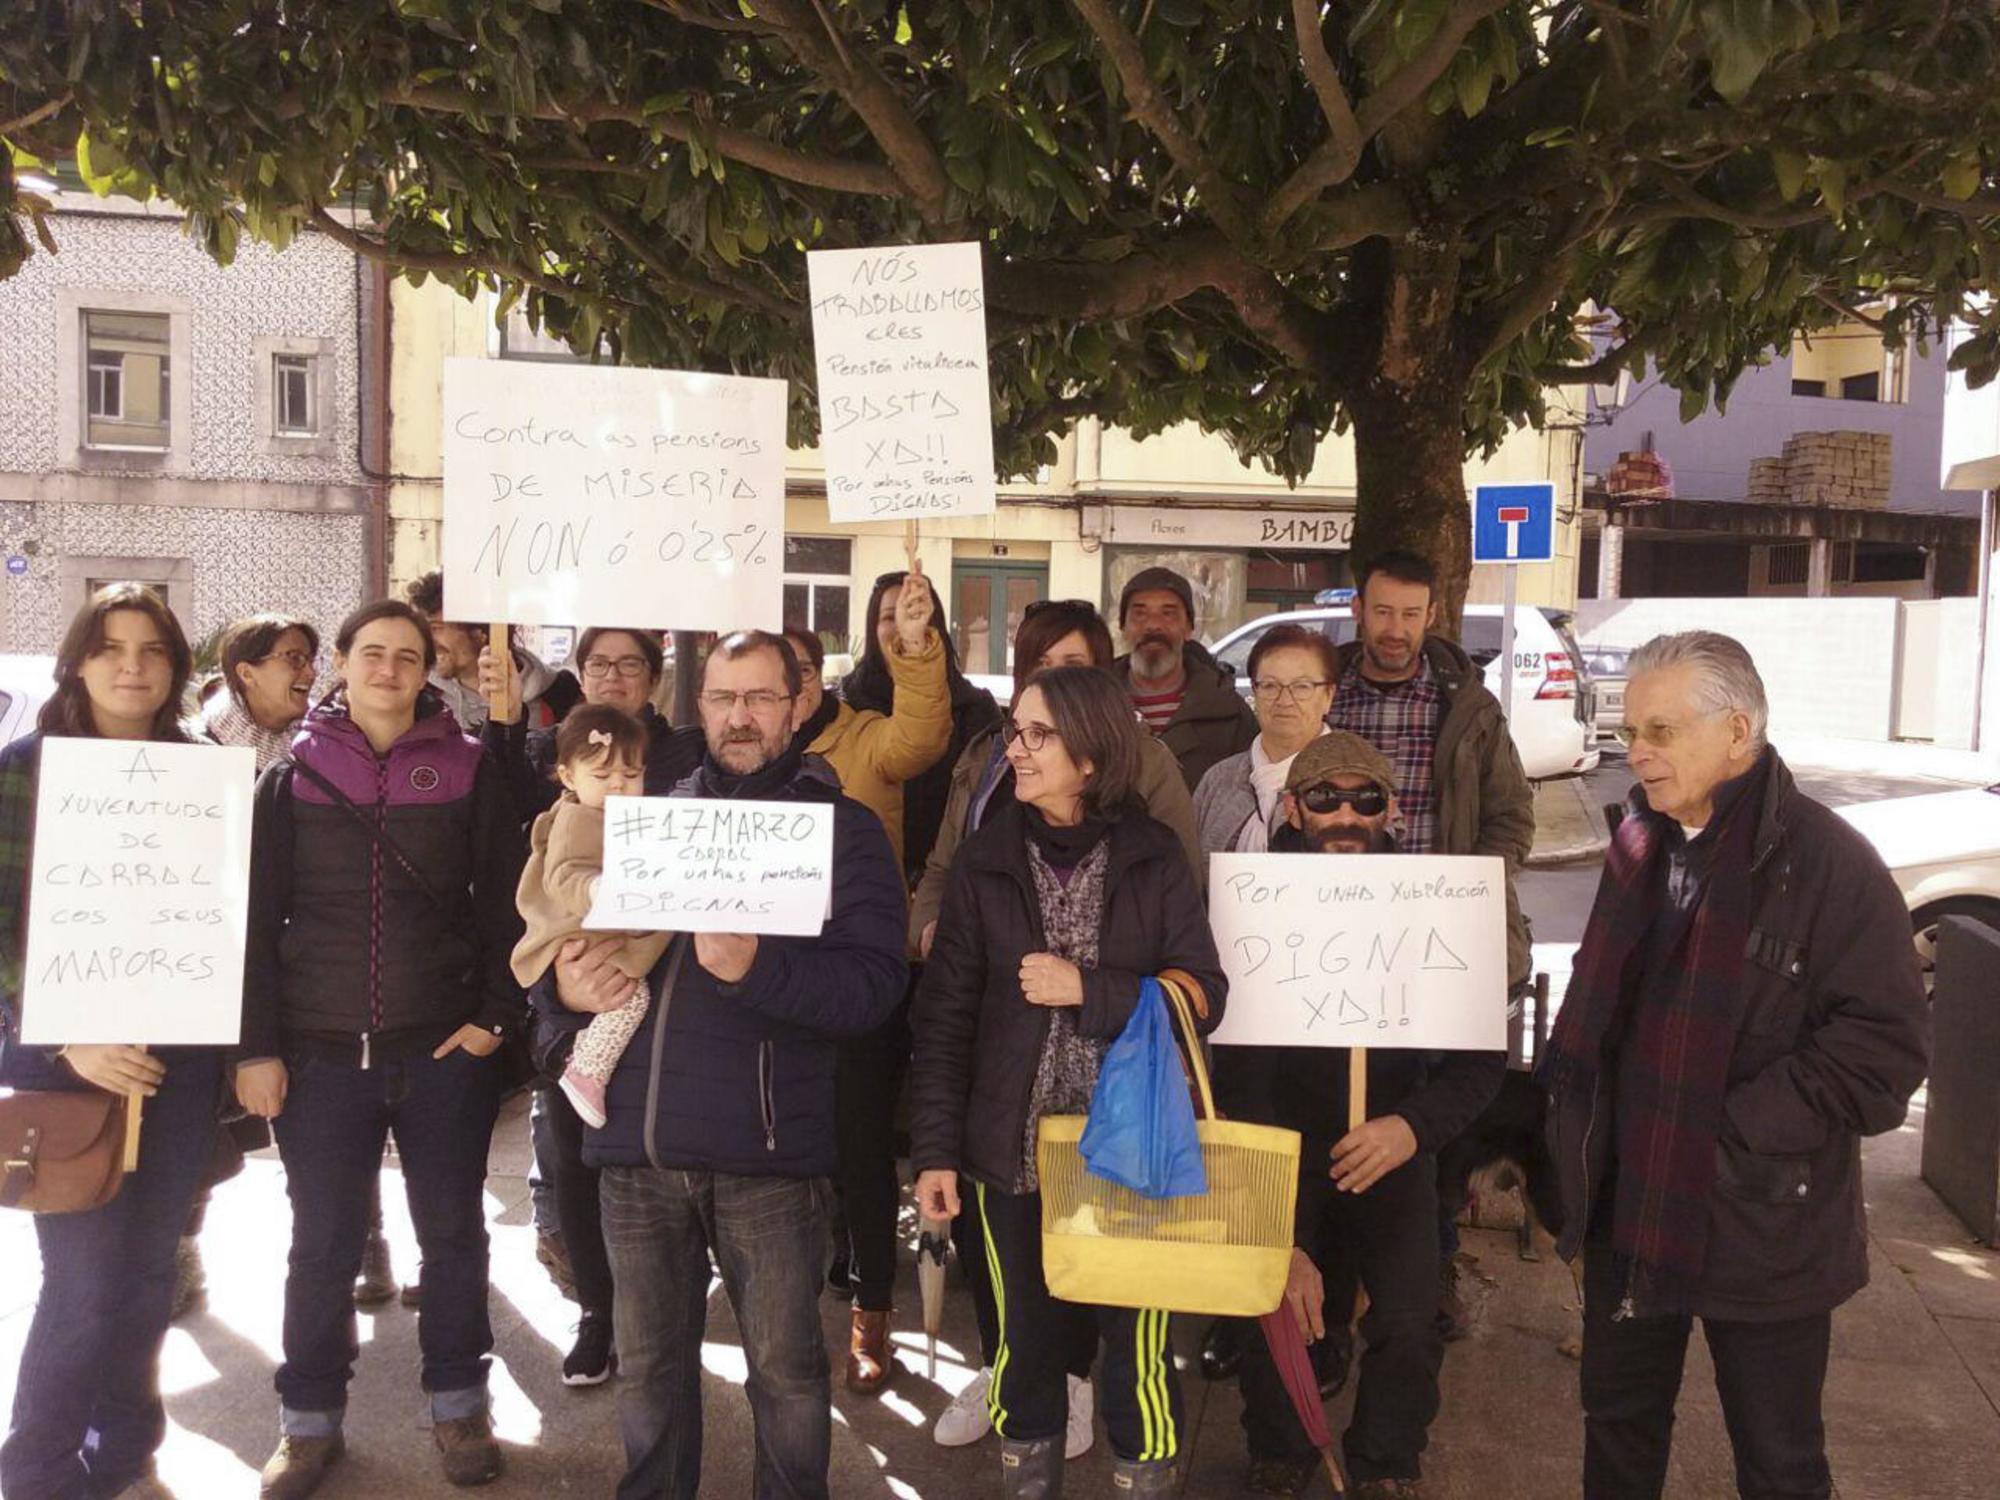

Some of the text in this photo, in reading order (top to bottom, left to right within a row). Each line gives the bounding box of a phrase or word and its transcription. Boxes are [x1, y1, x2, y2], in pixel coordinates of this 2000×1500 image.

[853, 251, 918, 286] NÓS
[831, 390, 960, 432] BASTA
[456, 411, 588, 448] Contra
[605, 434, 637, 448] as
[490, 473, 542, 502] DE
[832, 475, 863, 492] Por
[474, 516, 591, 577] NON
[1514, 653, 1541, 668] 062
[120, 747, 168, 783] A
[60, 793, 223, 819] XUVENTUDE
[120, 832, 161, 849] DE
[46, 863, 212, 888] CARRAL
[619, 858, 666, 879] Por
[1225, 872, 1290, 904] Por
[1318, 883, 1375, 903] UNHA
[1234, 927, 1468, 984] DIGNA
[1302, 983, 1411, 1030] XA!!
